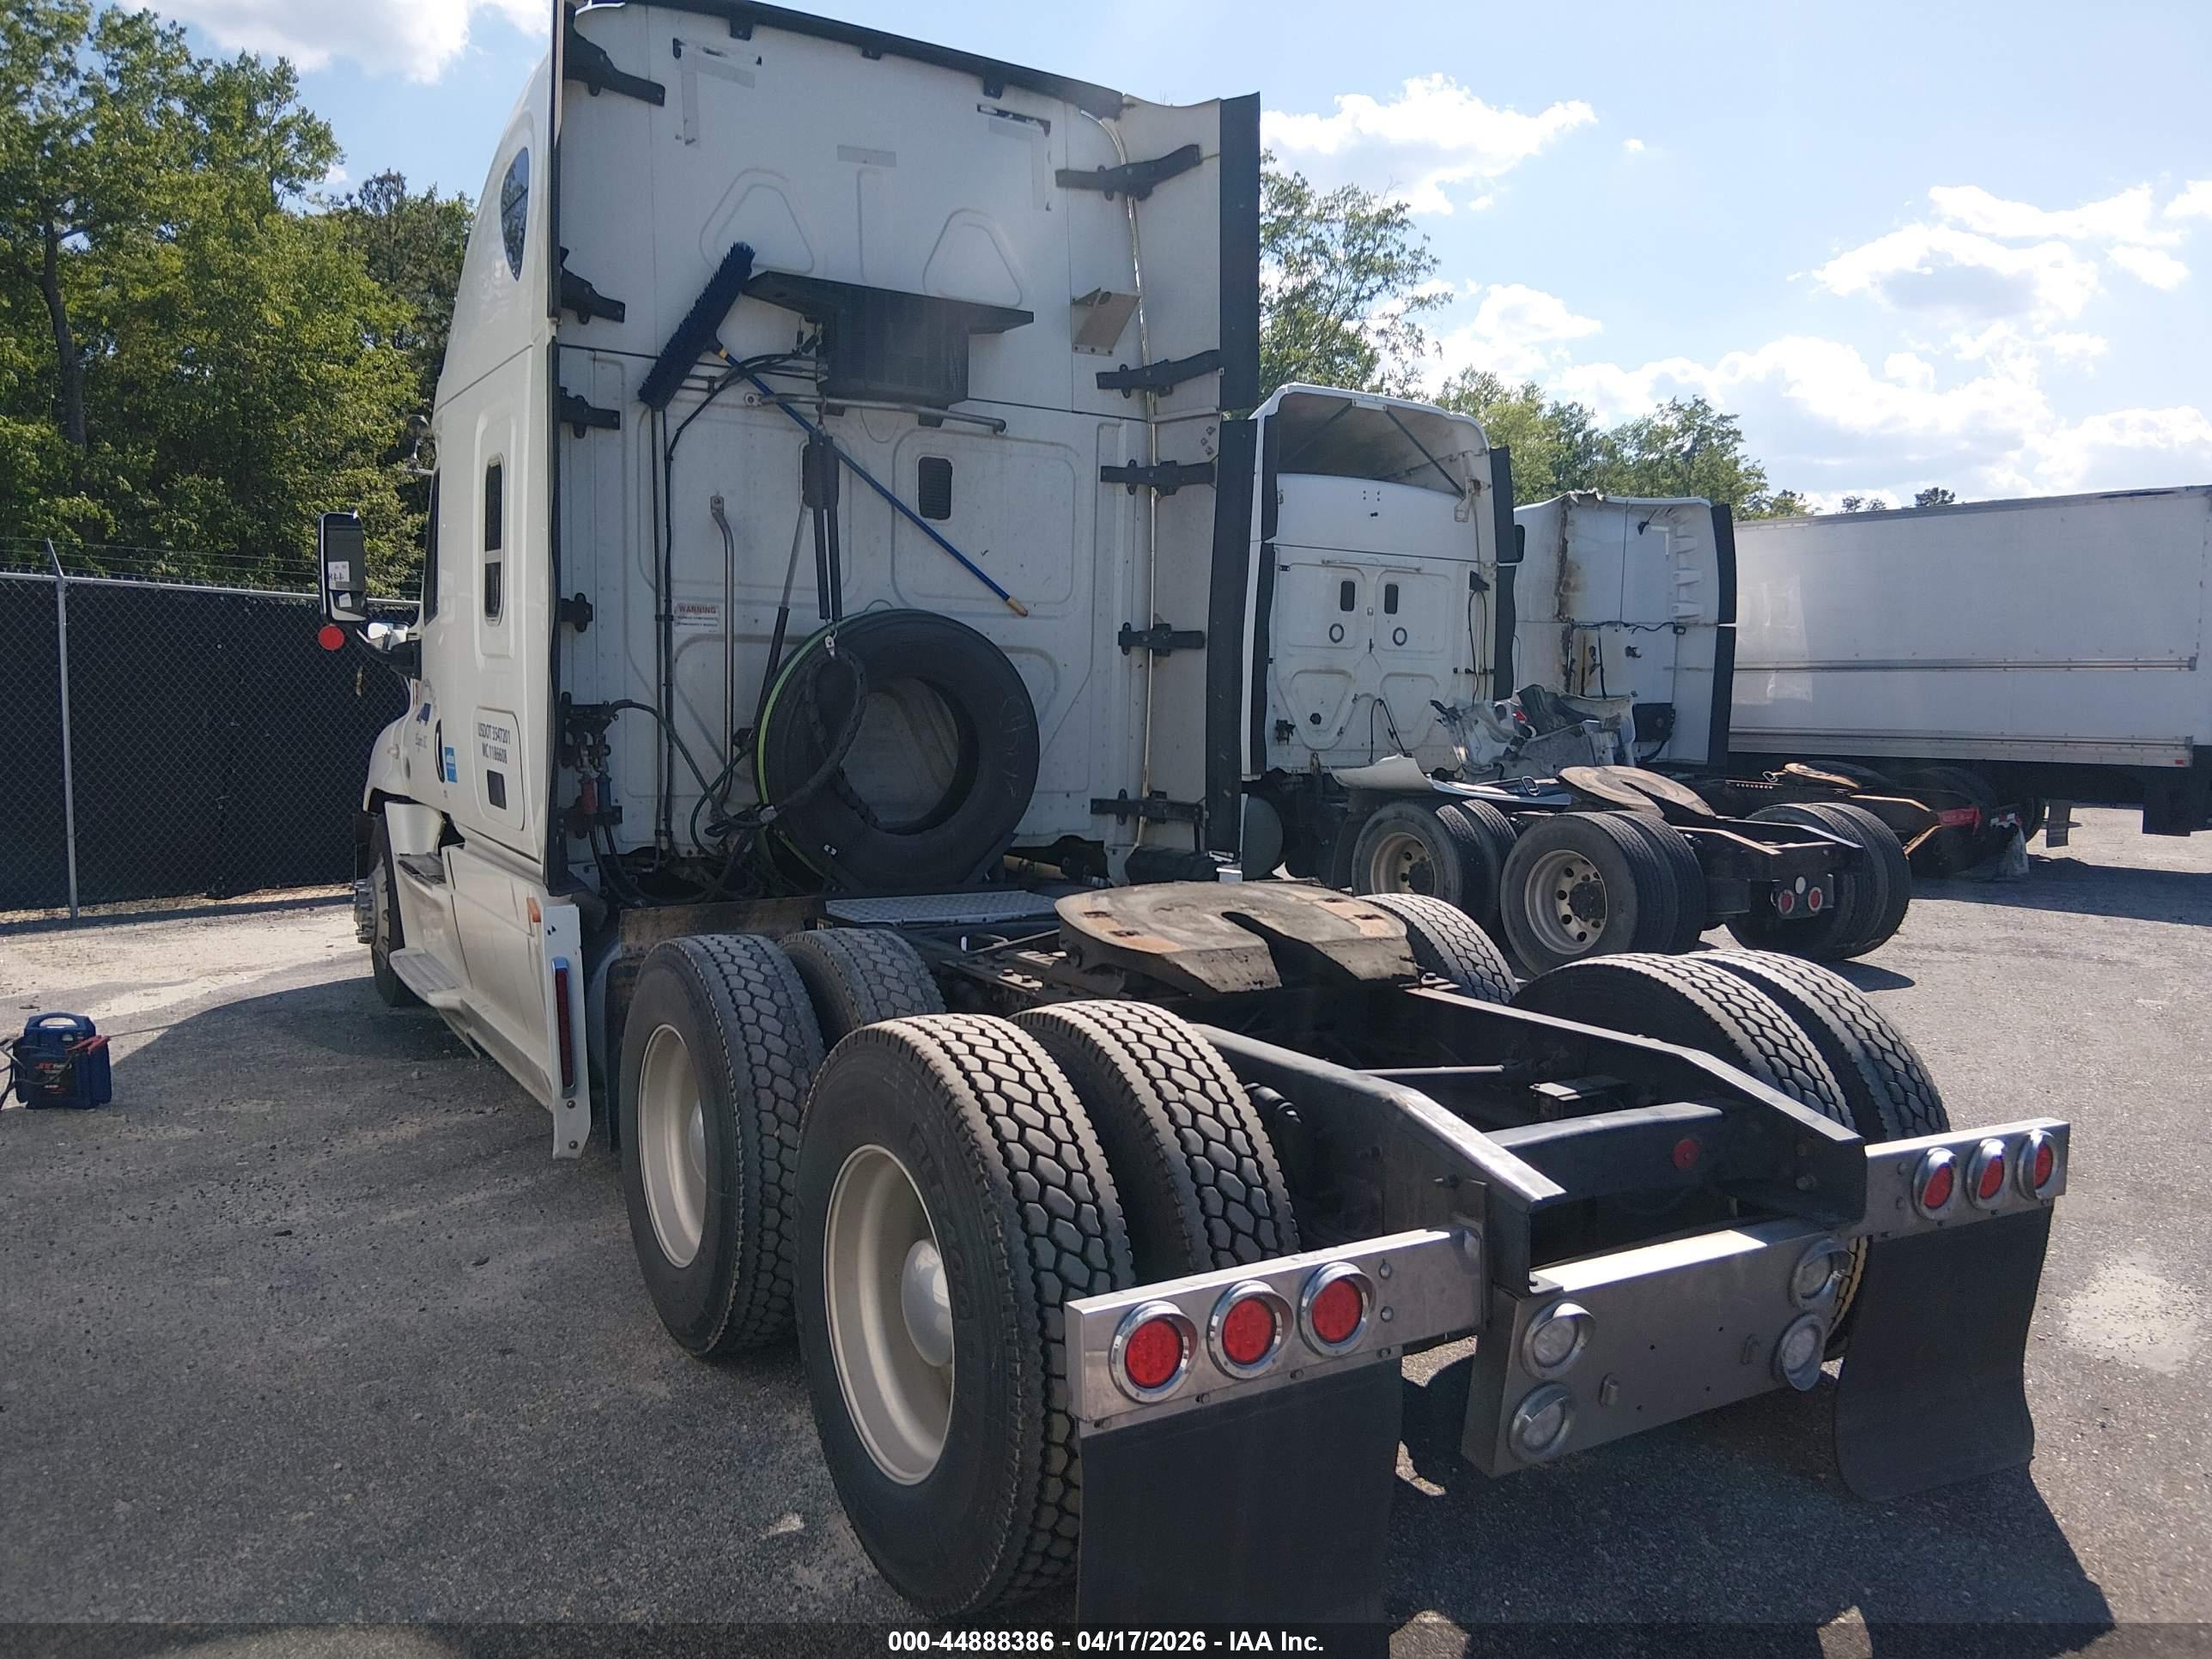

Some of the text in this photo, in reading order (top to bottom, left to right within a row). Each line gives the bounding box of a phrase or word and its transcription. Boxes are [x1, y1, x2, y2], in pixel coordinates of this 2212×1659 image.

[678, 605, 716, 614] WARNING
[478, 722, 492, 739] USDOT
[482, 742, 489, 759] MC
